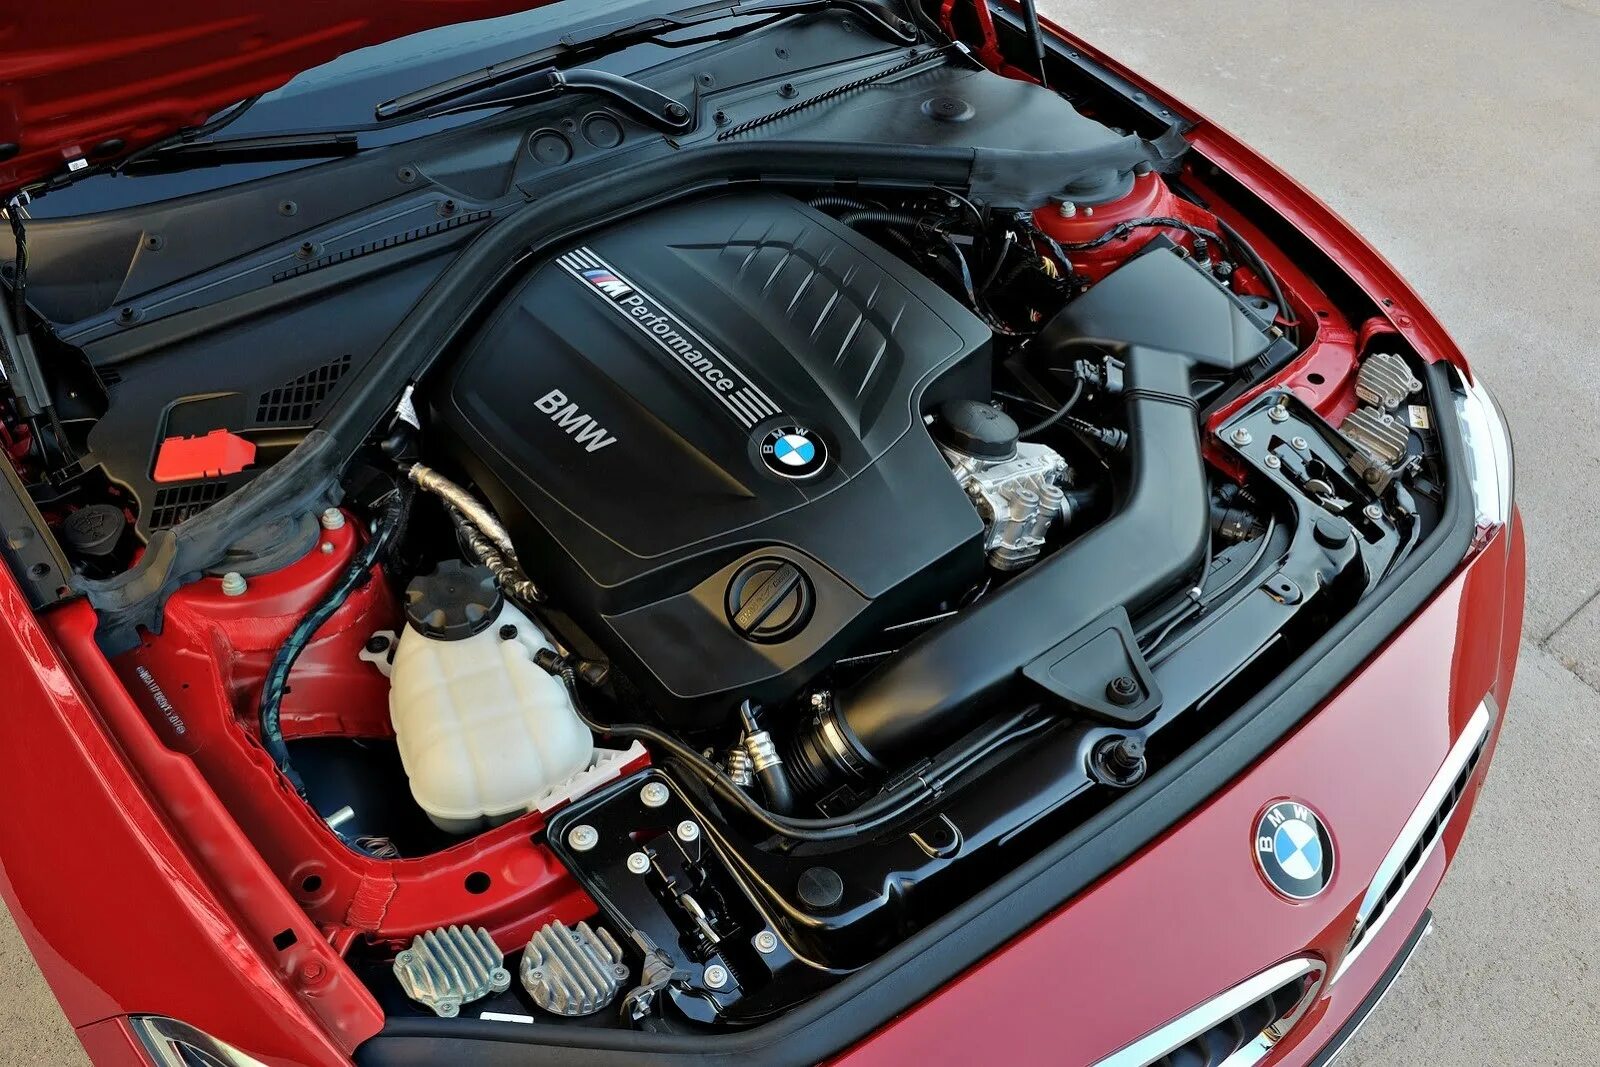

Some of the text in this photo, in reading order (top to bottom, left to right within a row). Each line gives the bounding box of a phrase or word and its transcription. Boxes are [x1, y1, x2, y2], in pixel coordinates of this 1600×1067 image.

[595, 279, 734, 392] M Performance
[533, 389, 617, 452] BMW
[763, 427, 808, 453] BMW
[1260, 805, 1307, 852] BMW
